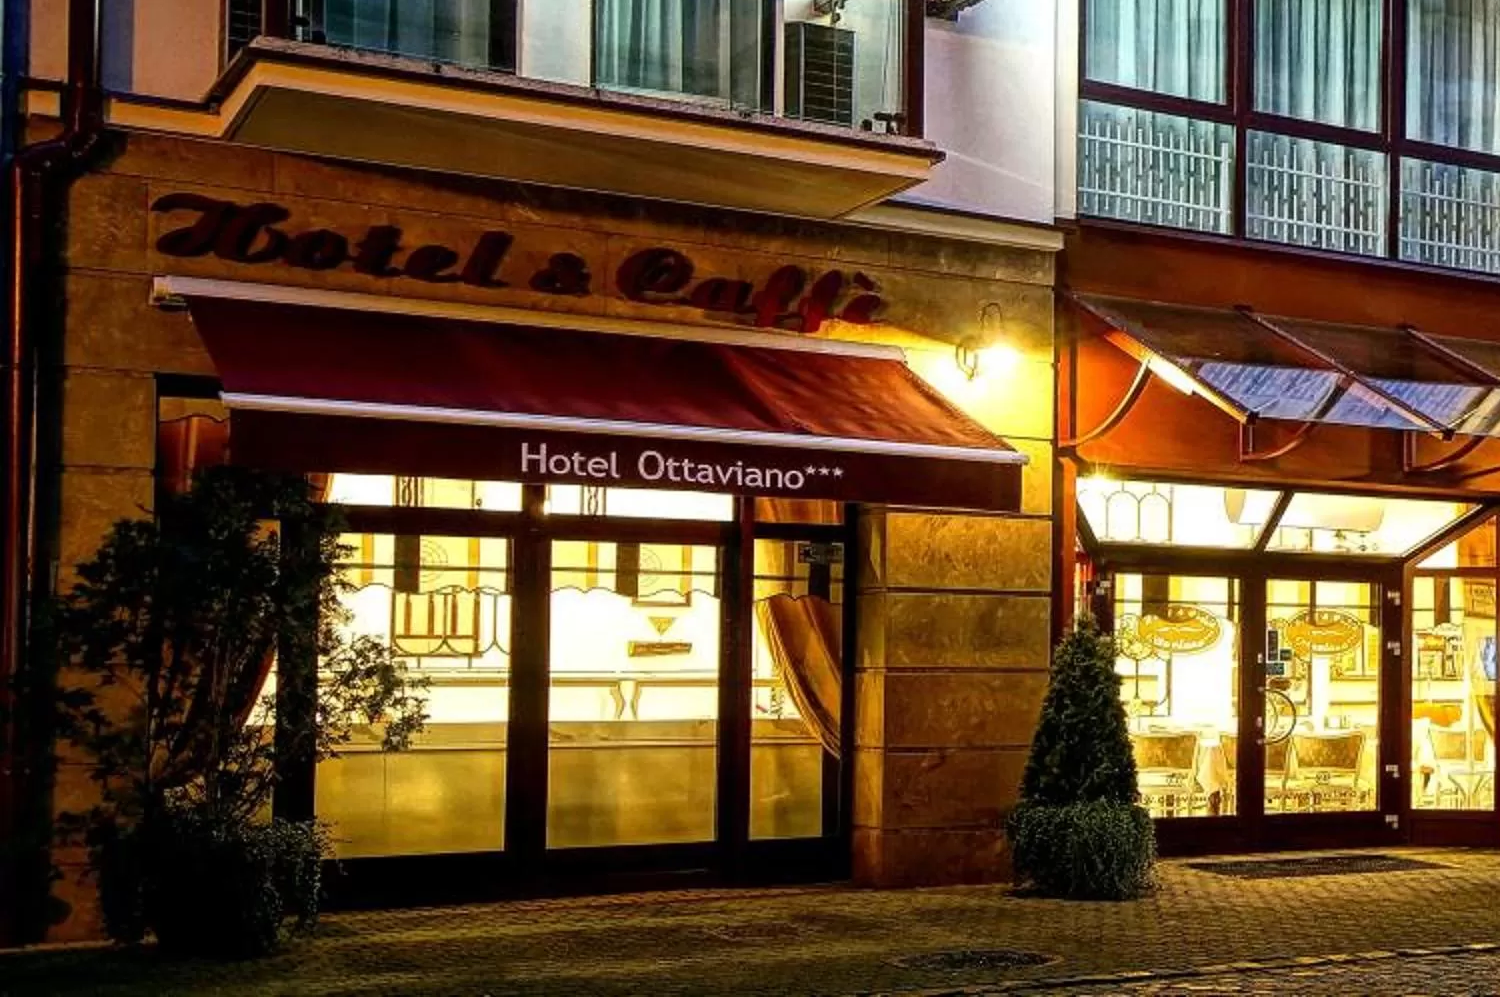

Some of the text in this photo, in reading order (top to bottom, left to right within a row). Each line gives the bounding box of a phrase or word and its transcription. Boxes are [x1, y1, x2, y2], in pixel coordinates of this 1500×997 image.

[151, 192, 514, 288] Hotel
[528, 252, 593, 297] &
[521, 442, 806, 490] Hotel Ottaviano
